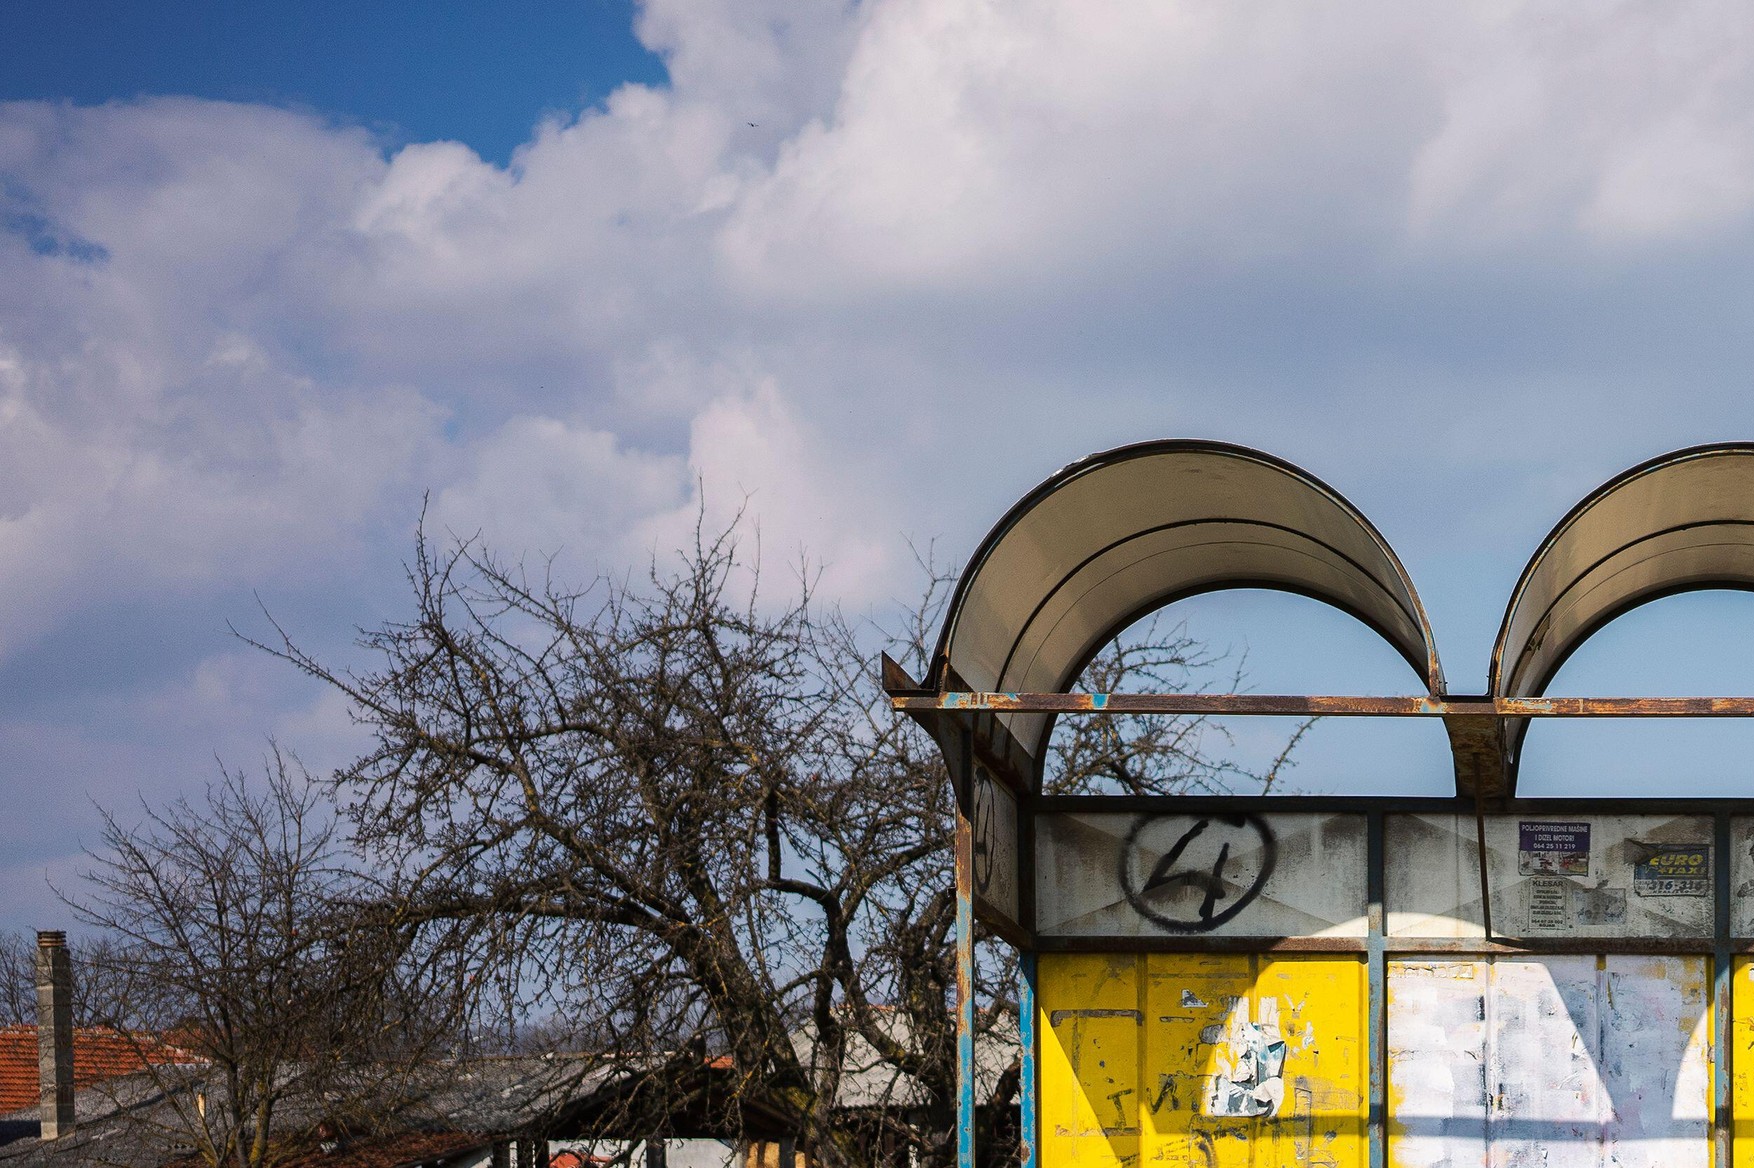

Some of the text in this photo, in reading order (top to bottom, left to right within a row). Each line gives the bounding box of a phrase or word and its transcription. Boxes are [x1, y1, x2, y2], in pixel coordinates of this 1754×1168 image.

[1521, 824, 1588, 833] POLJOPRIVREDNE MAŠINE
[1649, 854, 1704, 866] EURO
